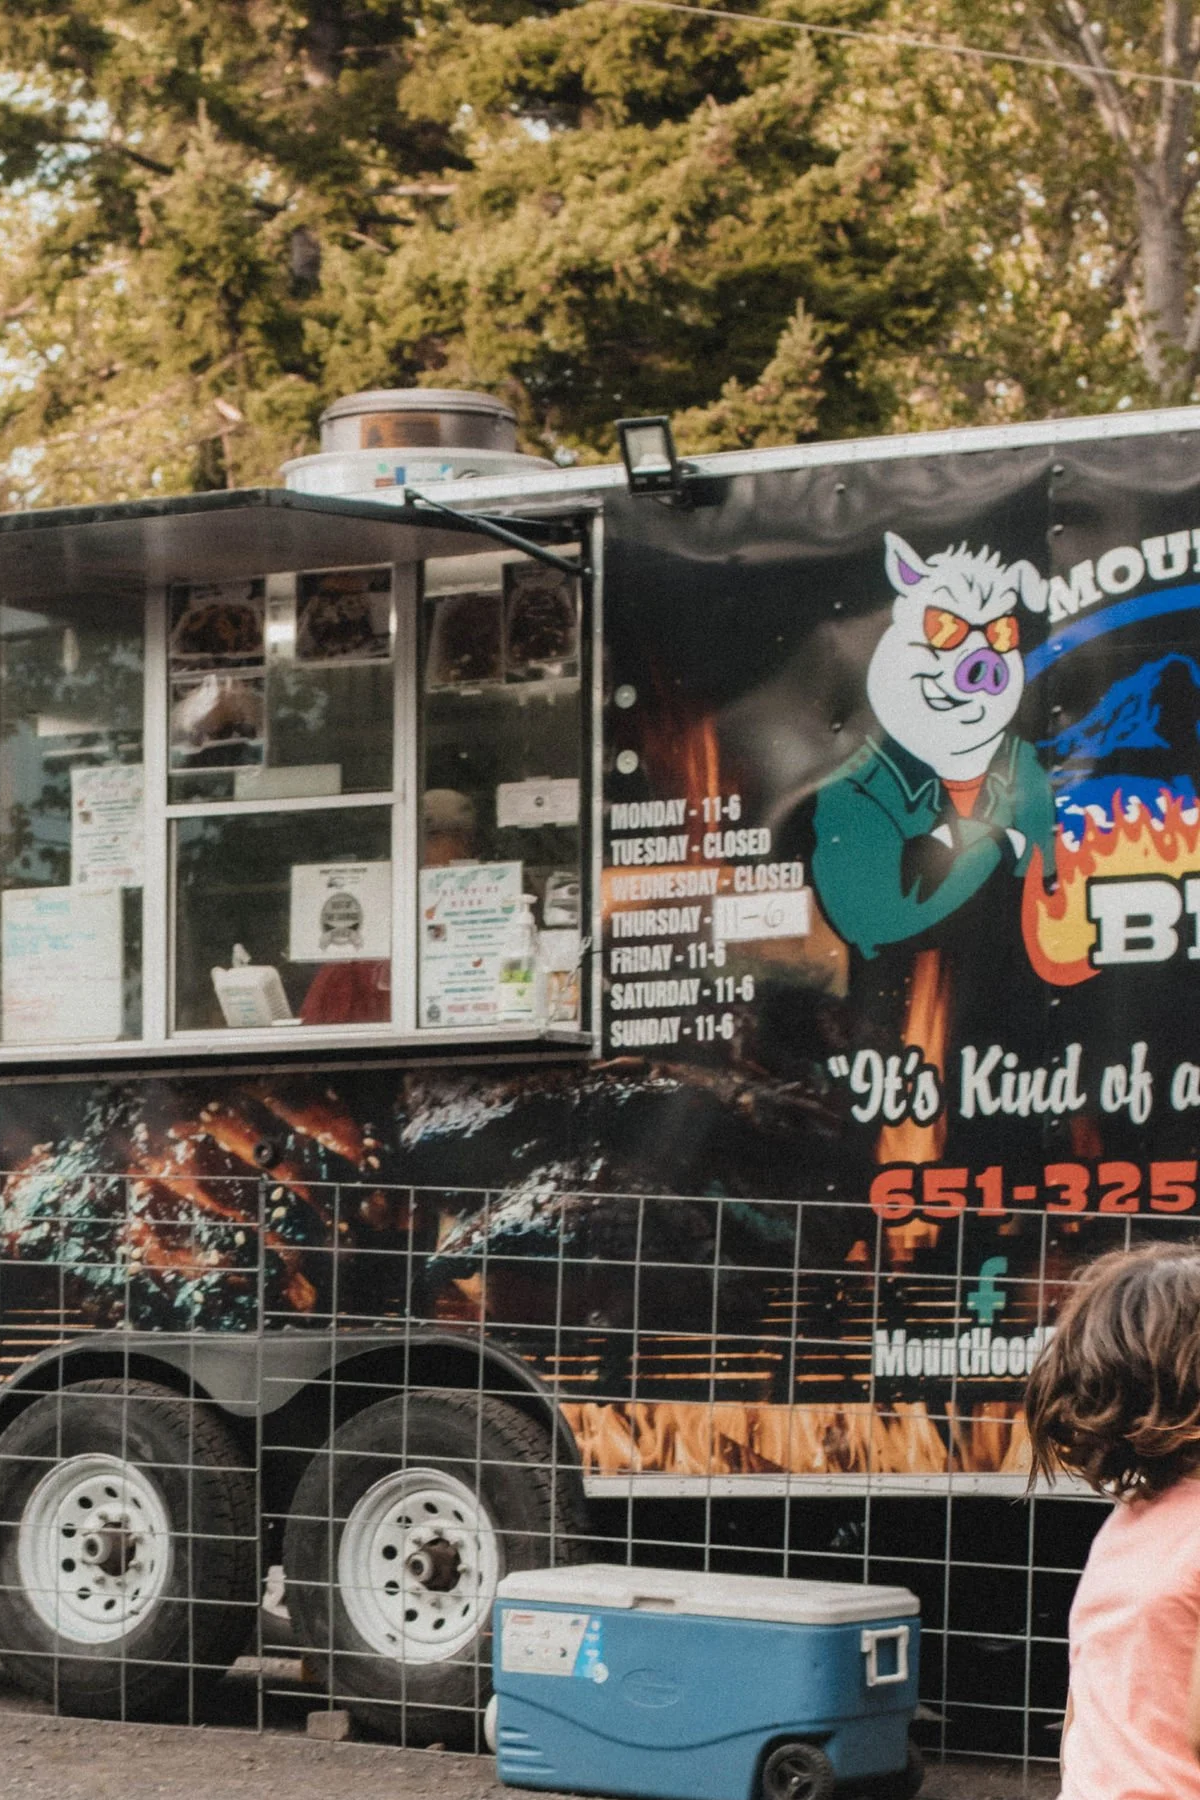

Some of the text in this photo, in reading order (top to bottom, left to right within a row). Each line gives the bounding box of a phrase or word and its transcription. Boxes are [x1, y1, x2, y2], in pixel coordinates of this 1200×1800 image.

[1047, 528, 1200, 623] MOU
[610, 798, 687, 831] MONDAY
[702, 794, 742, 823] 11-6
[610, 834, 690, 866] TUESDAY
[702, 827, 772, 860] CLOSED
[611, 868, 720, 902] WEDNESDAY
[733, 862, 804, 893] CLOSED
[610, 905, 702, 939] THURSDAY
[1089, 878, 1200, 965] B
[610, 943, 674, 975] FRIDAY
[610, 978, 701, 1011] SATURDAY
[714, 974, 755, 1003] 11-6
[610, 1016, 681, 1048] SUNDAY
[695, 1012, 735, 1041] 11-6
[959, 1042, 1087, 1119] Kind
[1100, 1040, 1153, 1125] of
[869, 1160, 1198, 1220] 651-325
[874, 1326, 1059, 1377] MountHood
